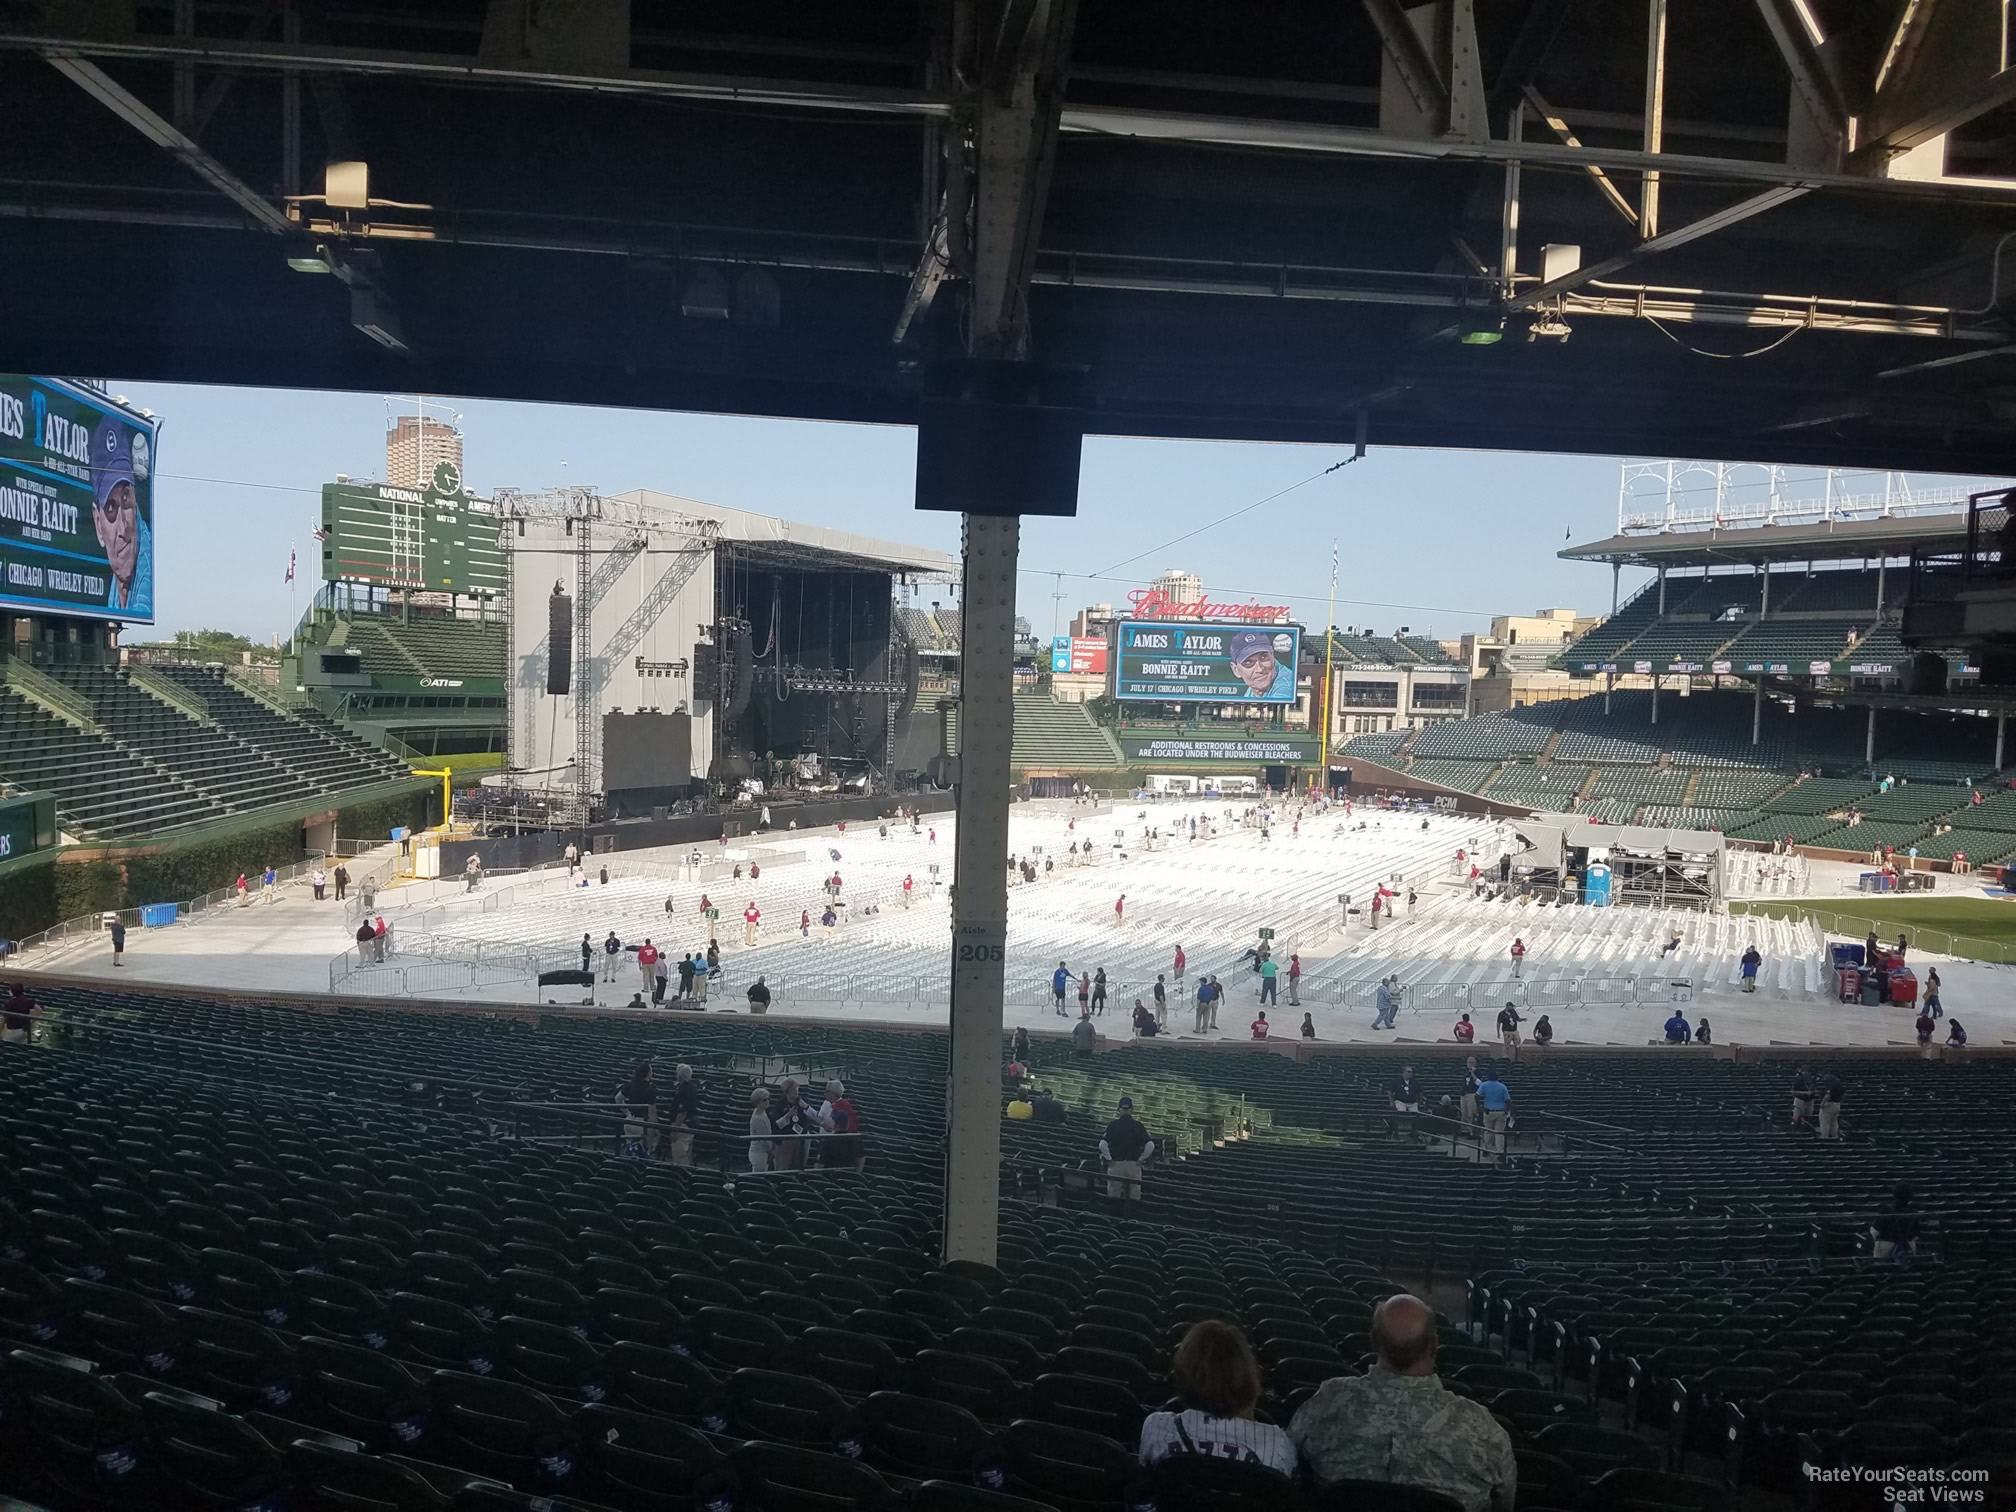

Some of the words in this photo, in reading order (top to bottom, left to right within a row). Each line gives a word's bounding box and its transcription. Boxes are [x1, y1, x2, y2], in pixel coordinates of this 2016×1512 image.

[32, 390, 90, 464] TAYLOR
[380, 487, 425, 503] NATIONAL
[42, 498, 78, 534] RAITT
[8, 562, 42, 588] CHICAGO
[48, 568, 82, 592] WRIGLEY
[84, 575, 104, 596] FIELD
[1128, 590, 1290, 619] Budweiser
[1126, 629, 1168, 648] JAMES
[1174, 630, 1222, 650] TAYLOR
[1142, 664, 1178, 674] BONNIE
[1180, 665, 1210, 676] RAITT
[1599, 661, 1617, 670] TAYLOR
[1744, 662, 1763, 672] JAMES
[1765, 660, 1788, 671] TAYLOR
[1151, 741, 1193, 750] ADDITIONAL
[1194, 742, 1235, 750] RESTROOMS
[1244, 742, 1290, 751] CONCESSIONS
[1224, 750, 1263, 759] BUDWEISER
[1265, 751, 1302, 759] BLEACHERS
[960, 945, 1003, 962] 205
